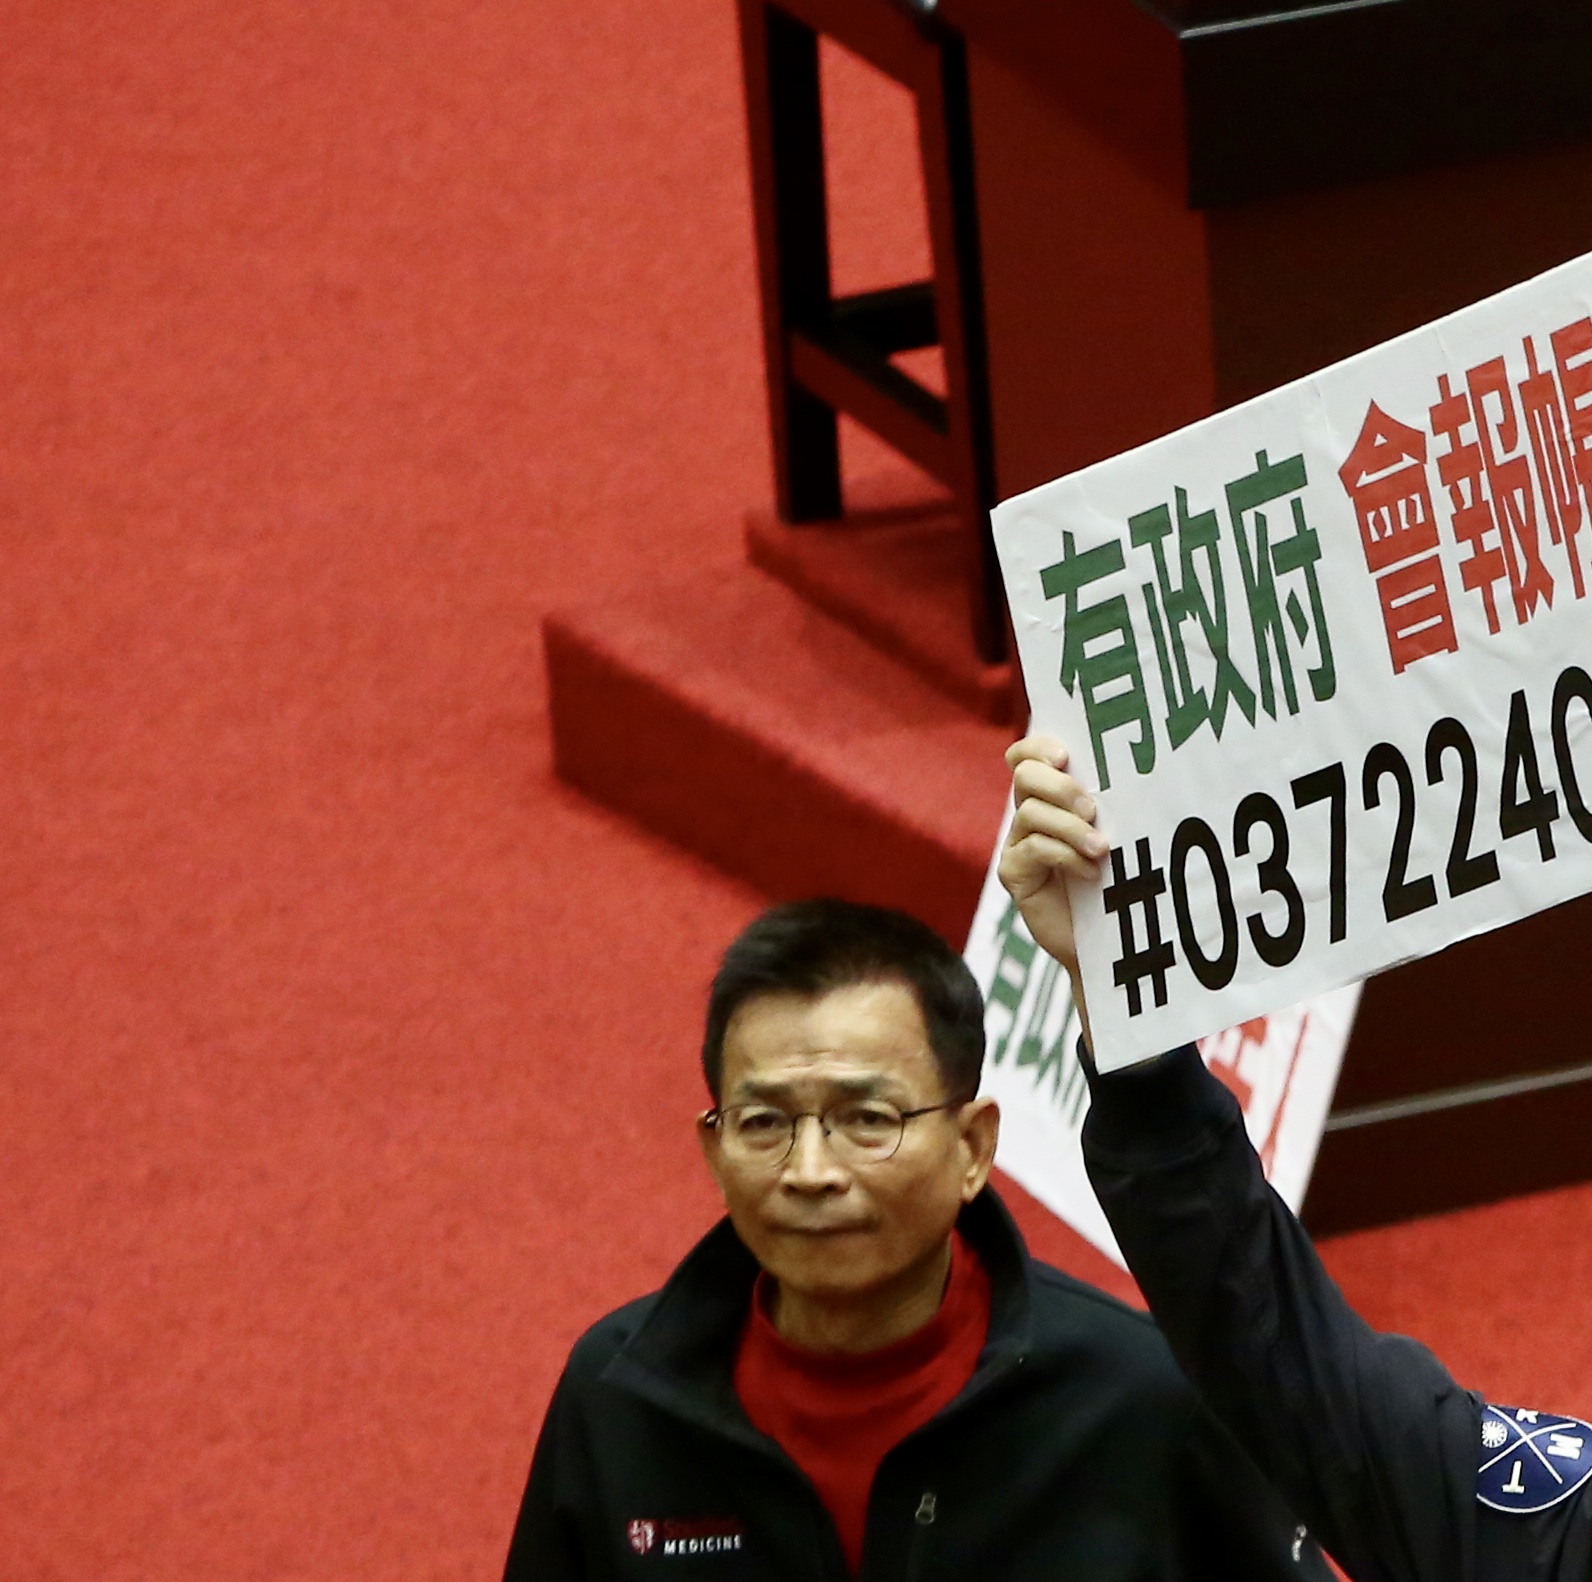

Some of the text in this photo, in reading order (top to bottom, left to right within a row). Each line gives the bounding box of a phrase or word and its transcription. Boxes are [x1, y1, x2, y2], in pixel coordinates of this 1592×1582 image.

[1040, 449, 1336, 791] 有政府
[663, 1534, 742, 1555] MEDICINE
